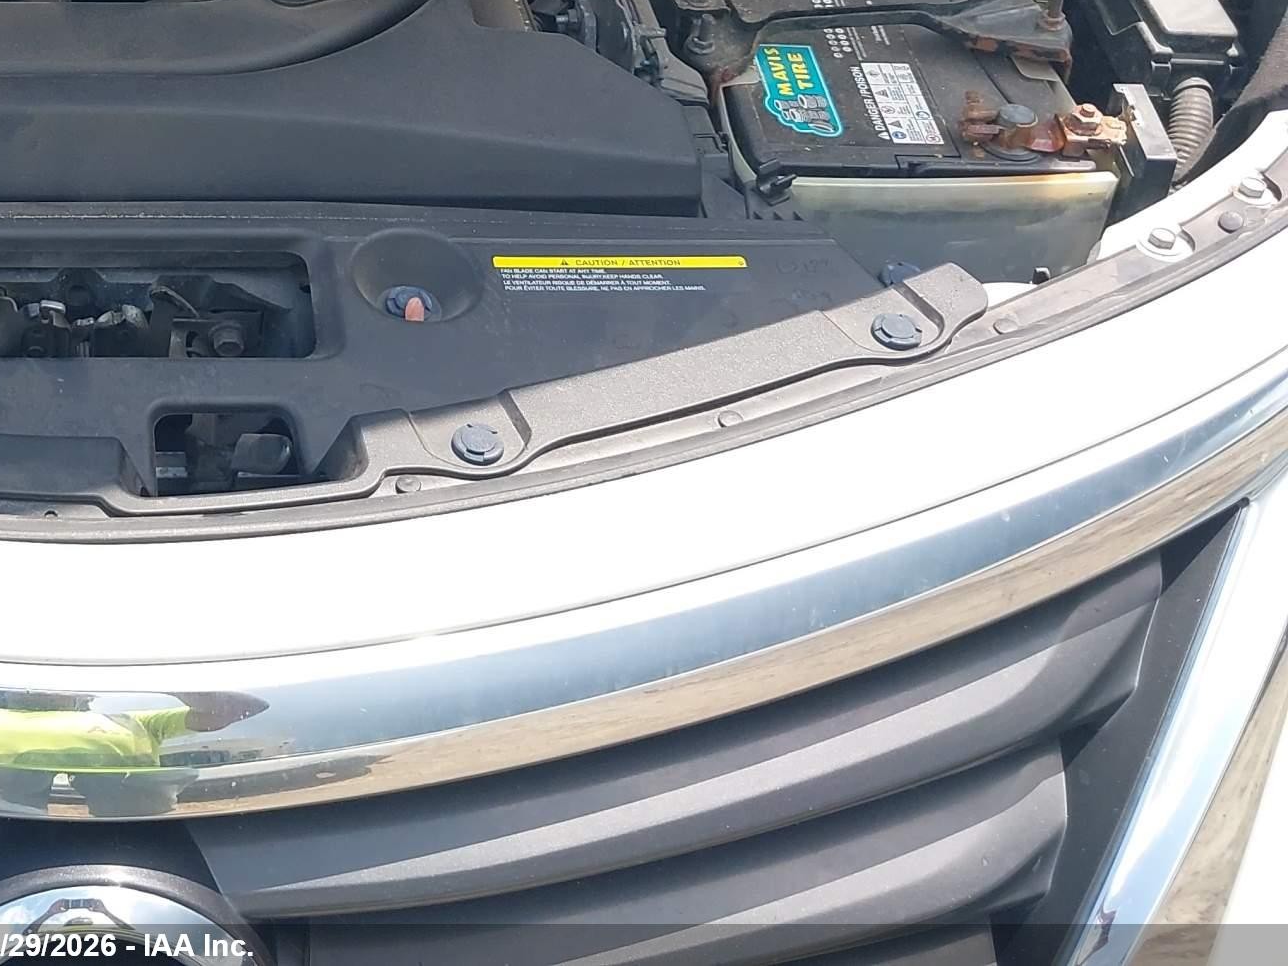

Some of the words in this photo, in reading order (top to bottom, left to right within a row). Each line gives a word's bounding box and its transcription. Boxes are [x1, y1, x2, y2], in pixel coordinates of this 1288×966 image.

[763, 47, 795, 96] MAVIS
[786, 52, 815, 90] TIRE
[863, 98, 887, 131] DANGER
